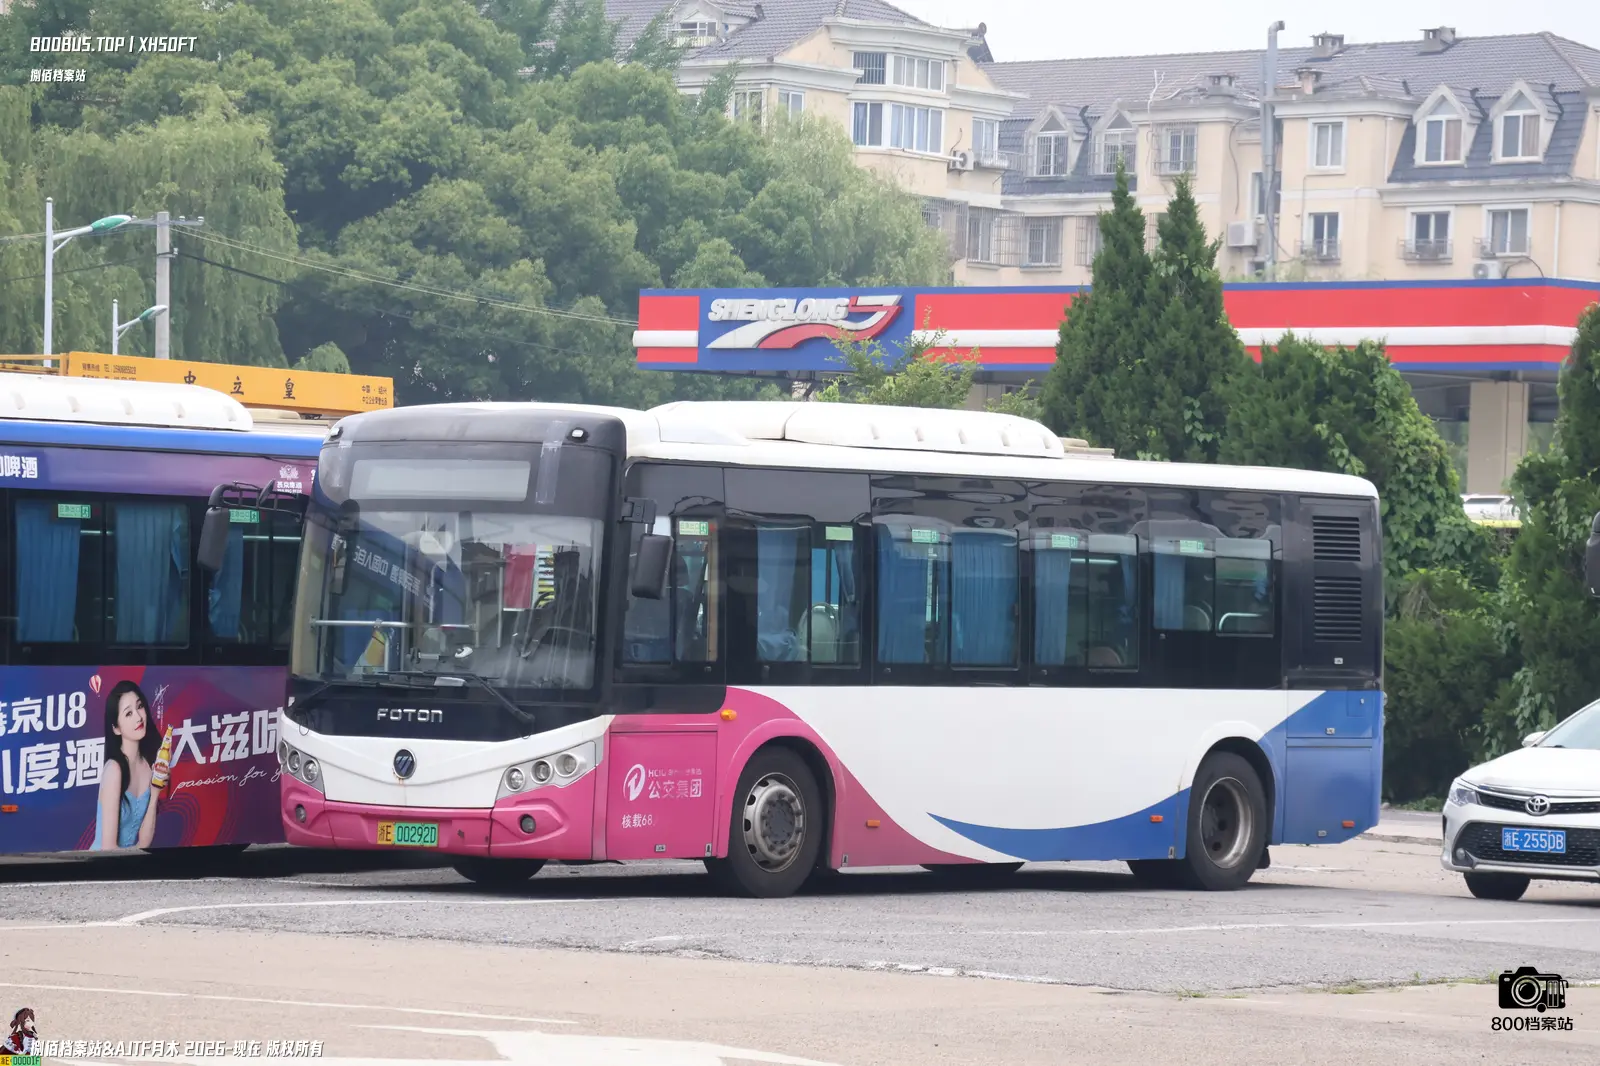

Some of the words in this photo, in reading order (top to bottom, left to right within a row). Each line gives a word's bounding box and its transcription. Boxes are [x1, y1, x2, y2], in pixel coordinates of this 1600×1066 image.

[708, 298, 849, 321] SHENGLONG
[0, 455, 38, 479] 啤酒
[0, 691, 87, 737] 京U8
[377, 708, 443, 723] FOTON
[169, 707, 283, 769] 大滋味
[169, 775, 238, 801] passion
[238, 766, 267, 787] for
[648, 779, 702, 799] 公交集团
[622, 814, 653, 829] 核载68
